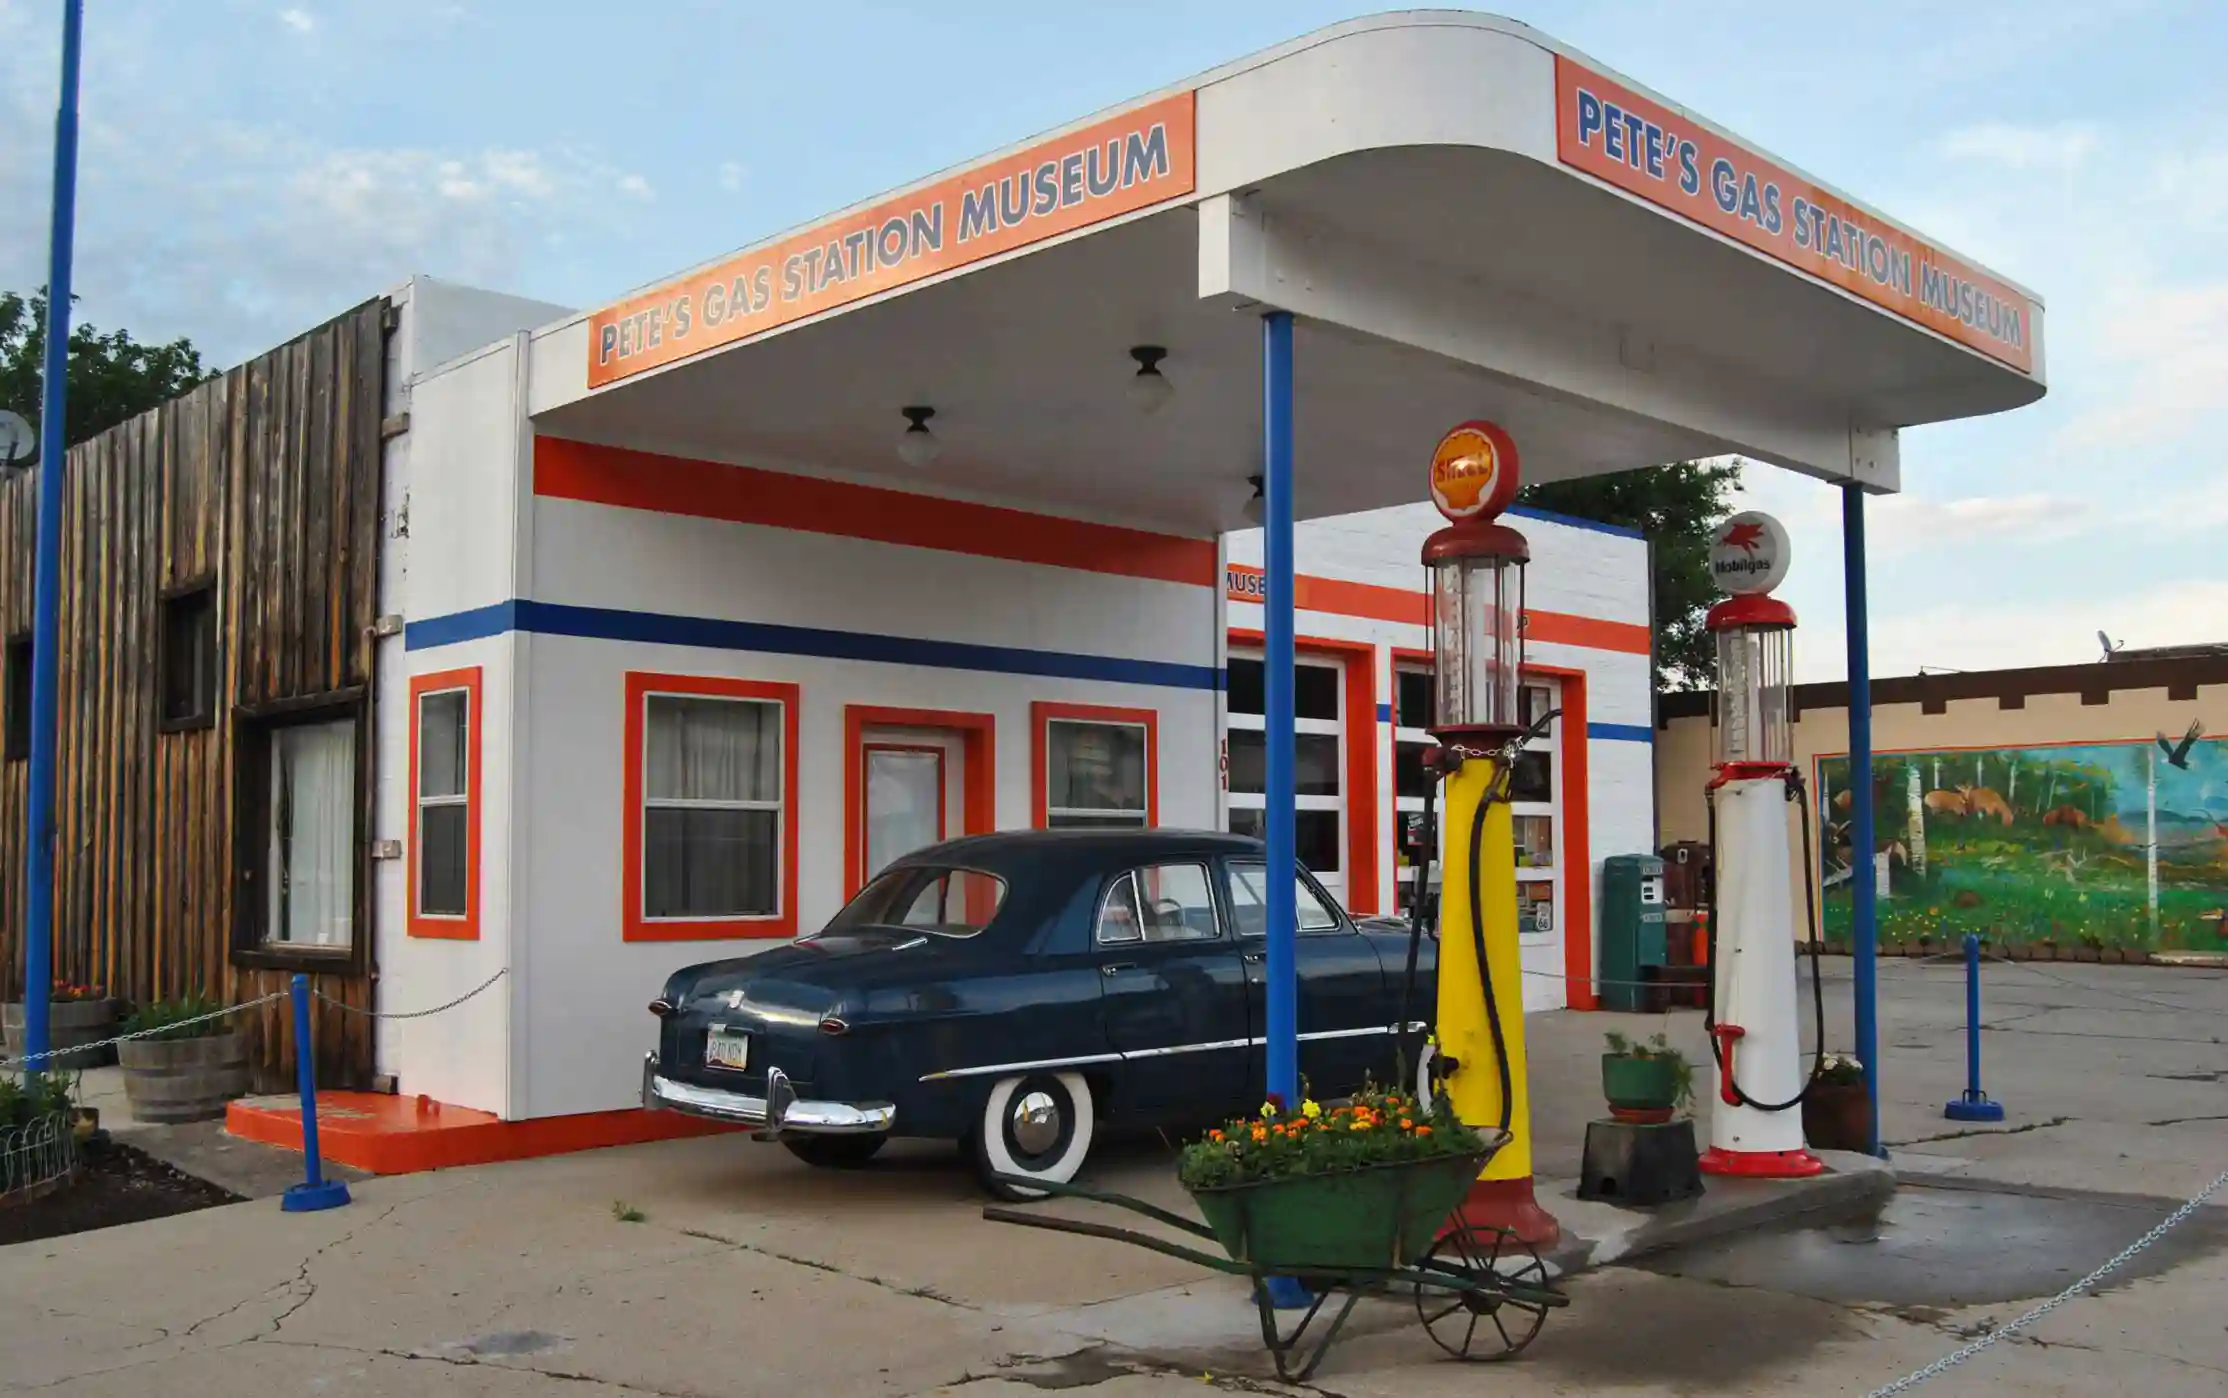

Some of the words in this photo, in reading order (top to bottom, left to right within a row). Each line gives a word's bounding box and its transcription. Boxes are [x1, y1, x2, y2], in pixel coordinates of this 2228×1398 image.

[600, 296, 690, 365] PETE'S
[702, 265, 773, 328] GAS
[781, 202, 943, 301] STATION
[957, 123, 1171, 242] MUSEUM
[1576, 88, 1700, 196] PETE'S
[1710, 158, 1782, 236] GAS
[1792, 196, 1911, 297] STATION
[1920, 261, 2022, 351] MUSEUM
[1715, 558, 1771, 575] Mobilgas
